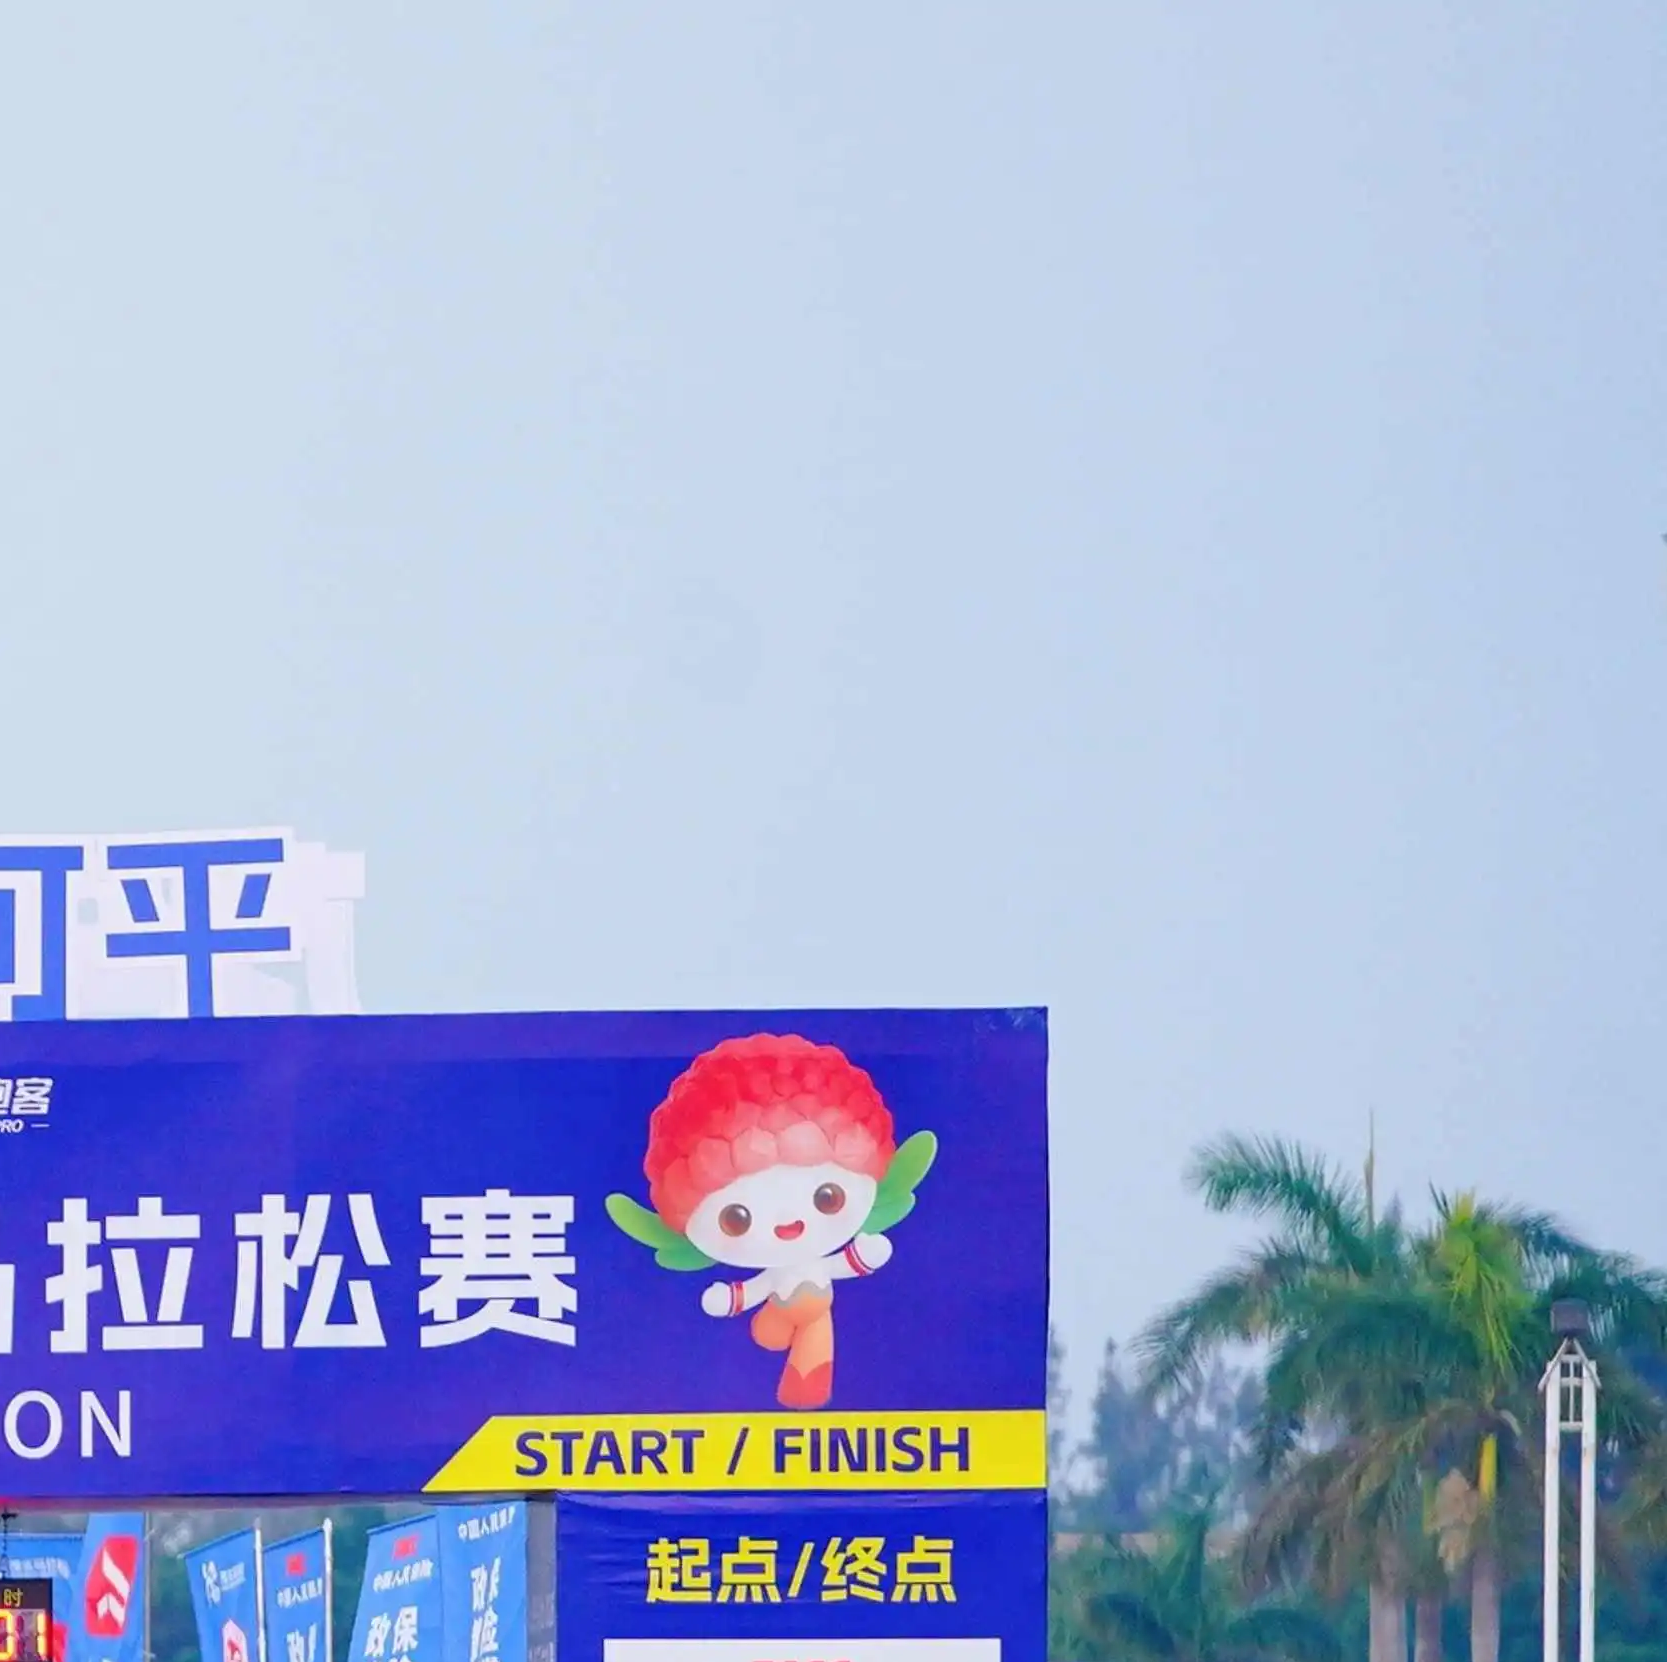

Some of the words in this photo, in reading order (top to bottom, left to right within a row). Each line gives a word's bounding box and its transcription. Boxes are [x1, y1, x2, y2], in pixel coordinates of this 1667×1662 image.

[513, 1428, 704, 1477] START
[772, 1427, 971, 1475] FINISH
[646, 1536, 956, 1602] 起点/终点
